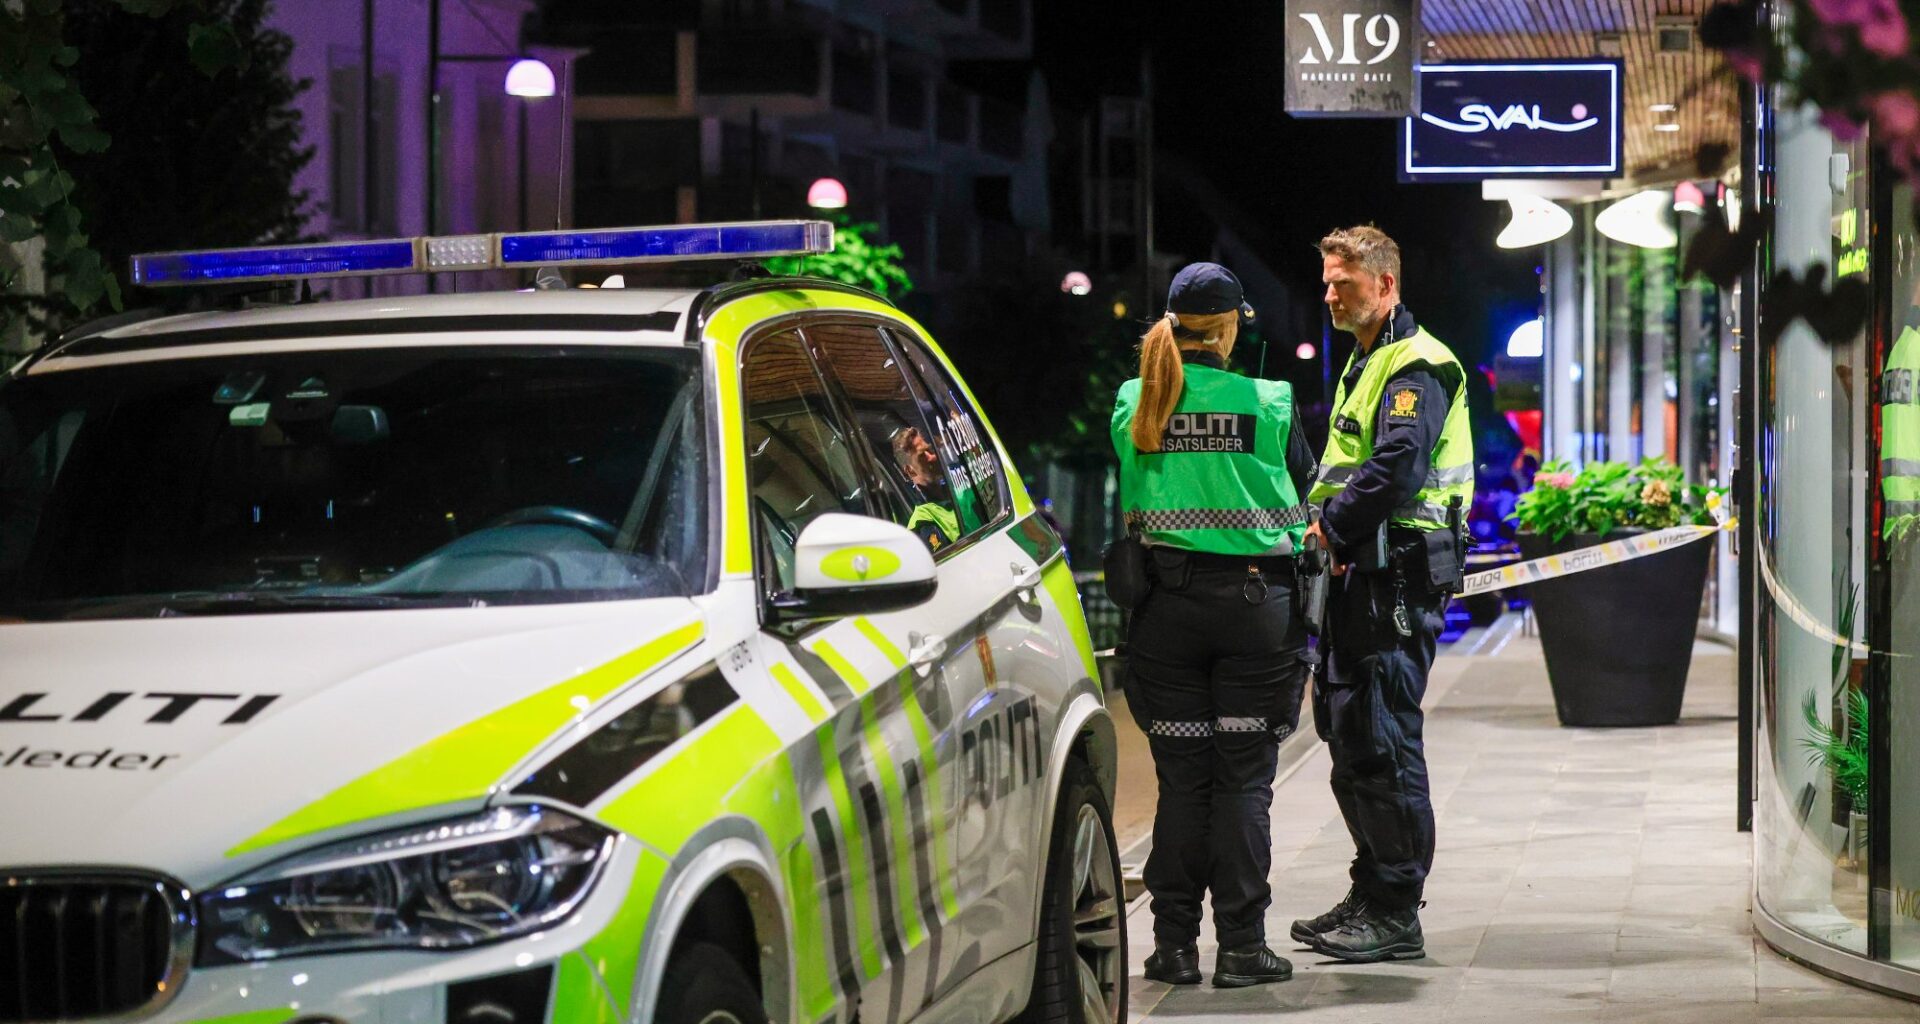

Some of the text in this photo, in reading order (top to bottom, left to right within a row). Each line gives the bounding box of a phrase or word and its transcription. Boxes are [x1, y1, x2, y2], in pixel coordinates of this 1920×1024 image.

[1299, 13, 1400, 65] M9
[1421, 104, 1598, 133] SVAL
[1162, 413, 1239, 436] OLITI
[1390, 409, 1416, 418] POLITI
[0, 692, 282, 725] LITI
[0, 746, 180, 770] leder
